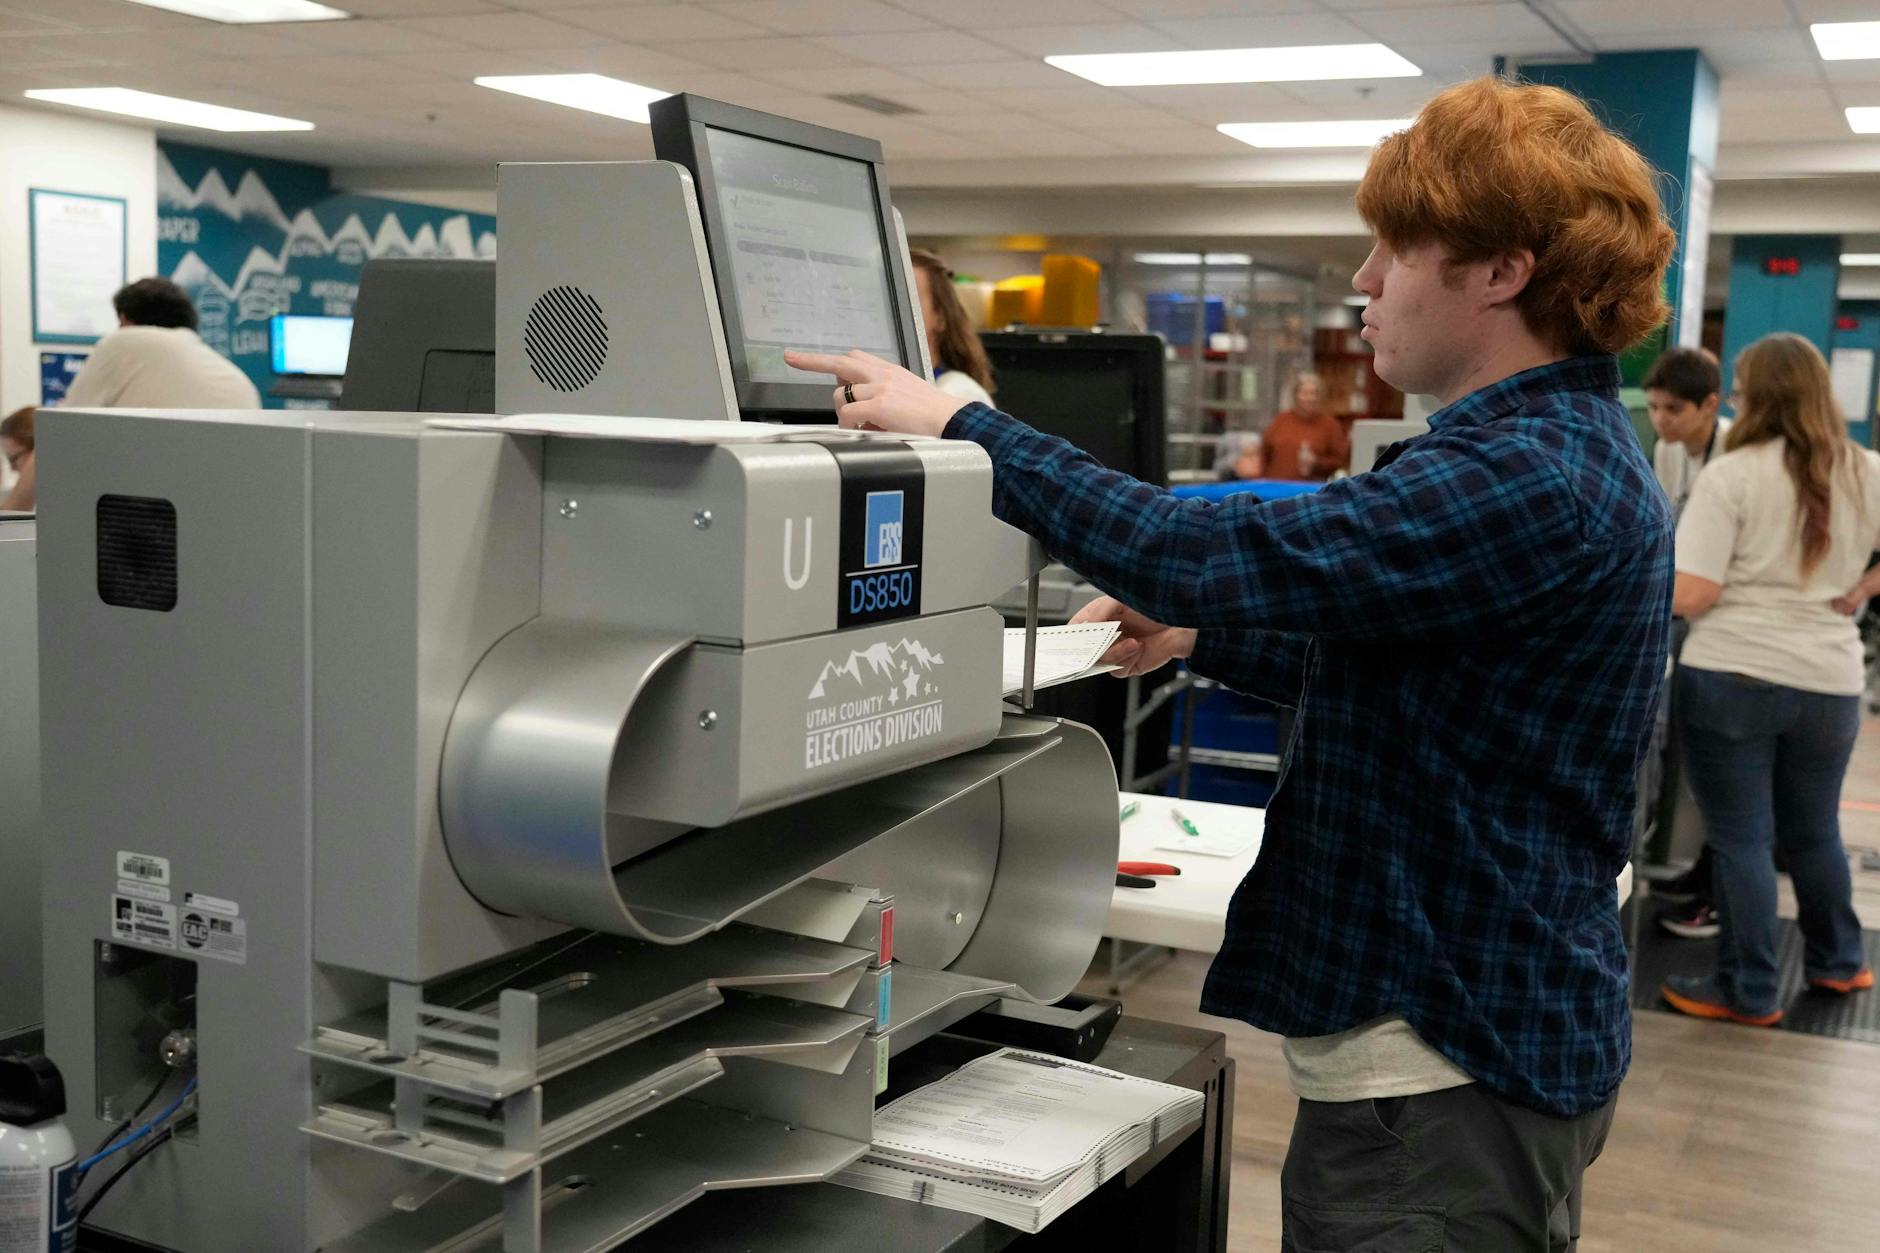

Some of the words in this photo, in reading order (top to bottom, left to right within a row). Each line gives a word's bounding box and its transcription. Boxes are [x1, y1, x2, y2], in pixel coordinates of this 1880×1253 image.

[783, 516, 812, 590] U
[850, 571, 913, 614] DS850
[805, 719, 883, 769] ELECTIONS
[885, 703, 943, 748] DIVISION
[806, 706, 837, 729] UTAH
[840, 695, 884, 721] COUNTY
